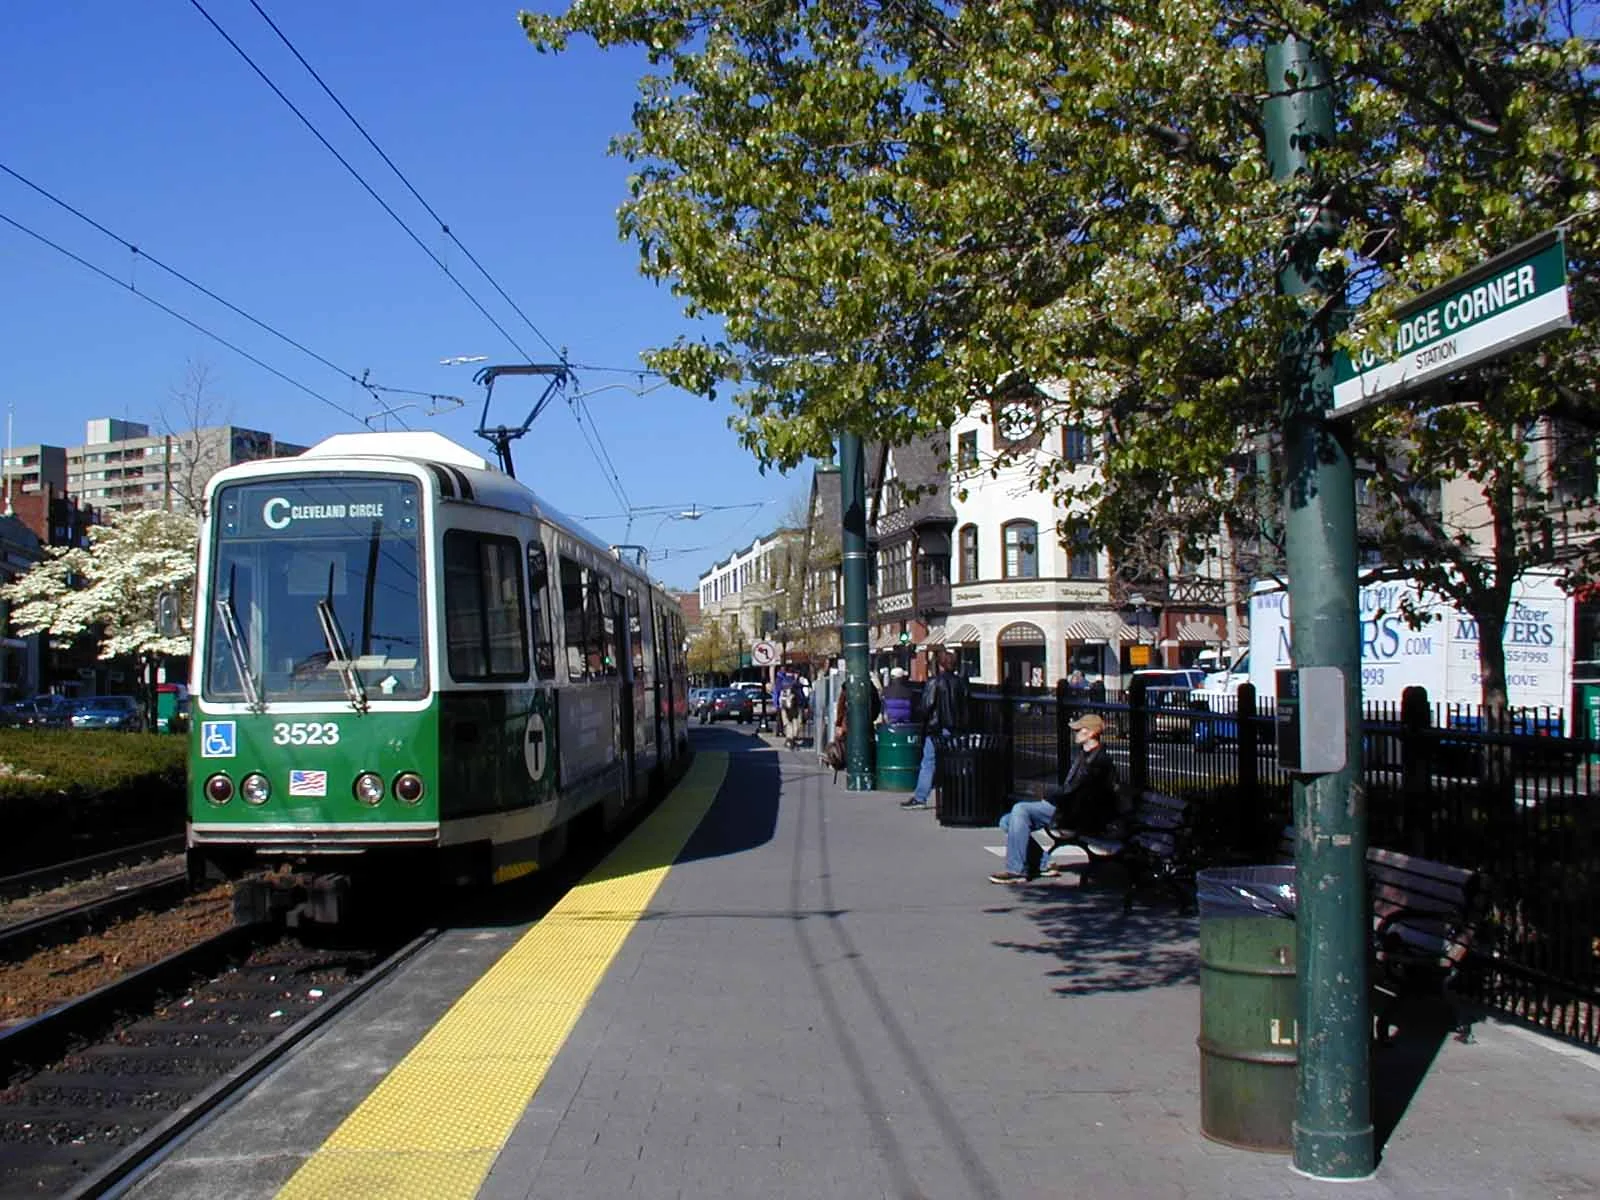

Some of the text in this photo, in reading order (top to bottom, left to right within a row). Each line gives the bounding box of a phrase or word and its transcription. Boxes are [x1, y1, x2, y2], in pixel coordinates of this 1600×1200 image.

[1444, 264, 1536, 330] CORNER
[1415, 340, 1458, 370] STATION
[263, 497, 384, 530] C CLEVELAND CIRCLE
[1454, 618, 1553, 645] MERS
[273, 722, 340, 745] 3523
[528, 730, 543, 771] T
